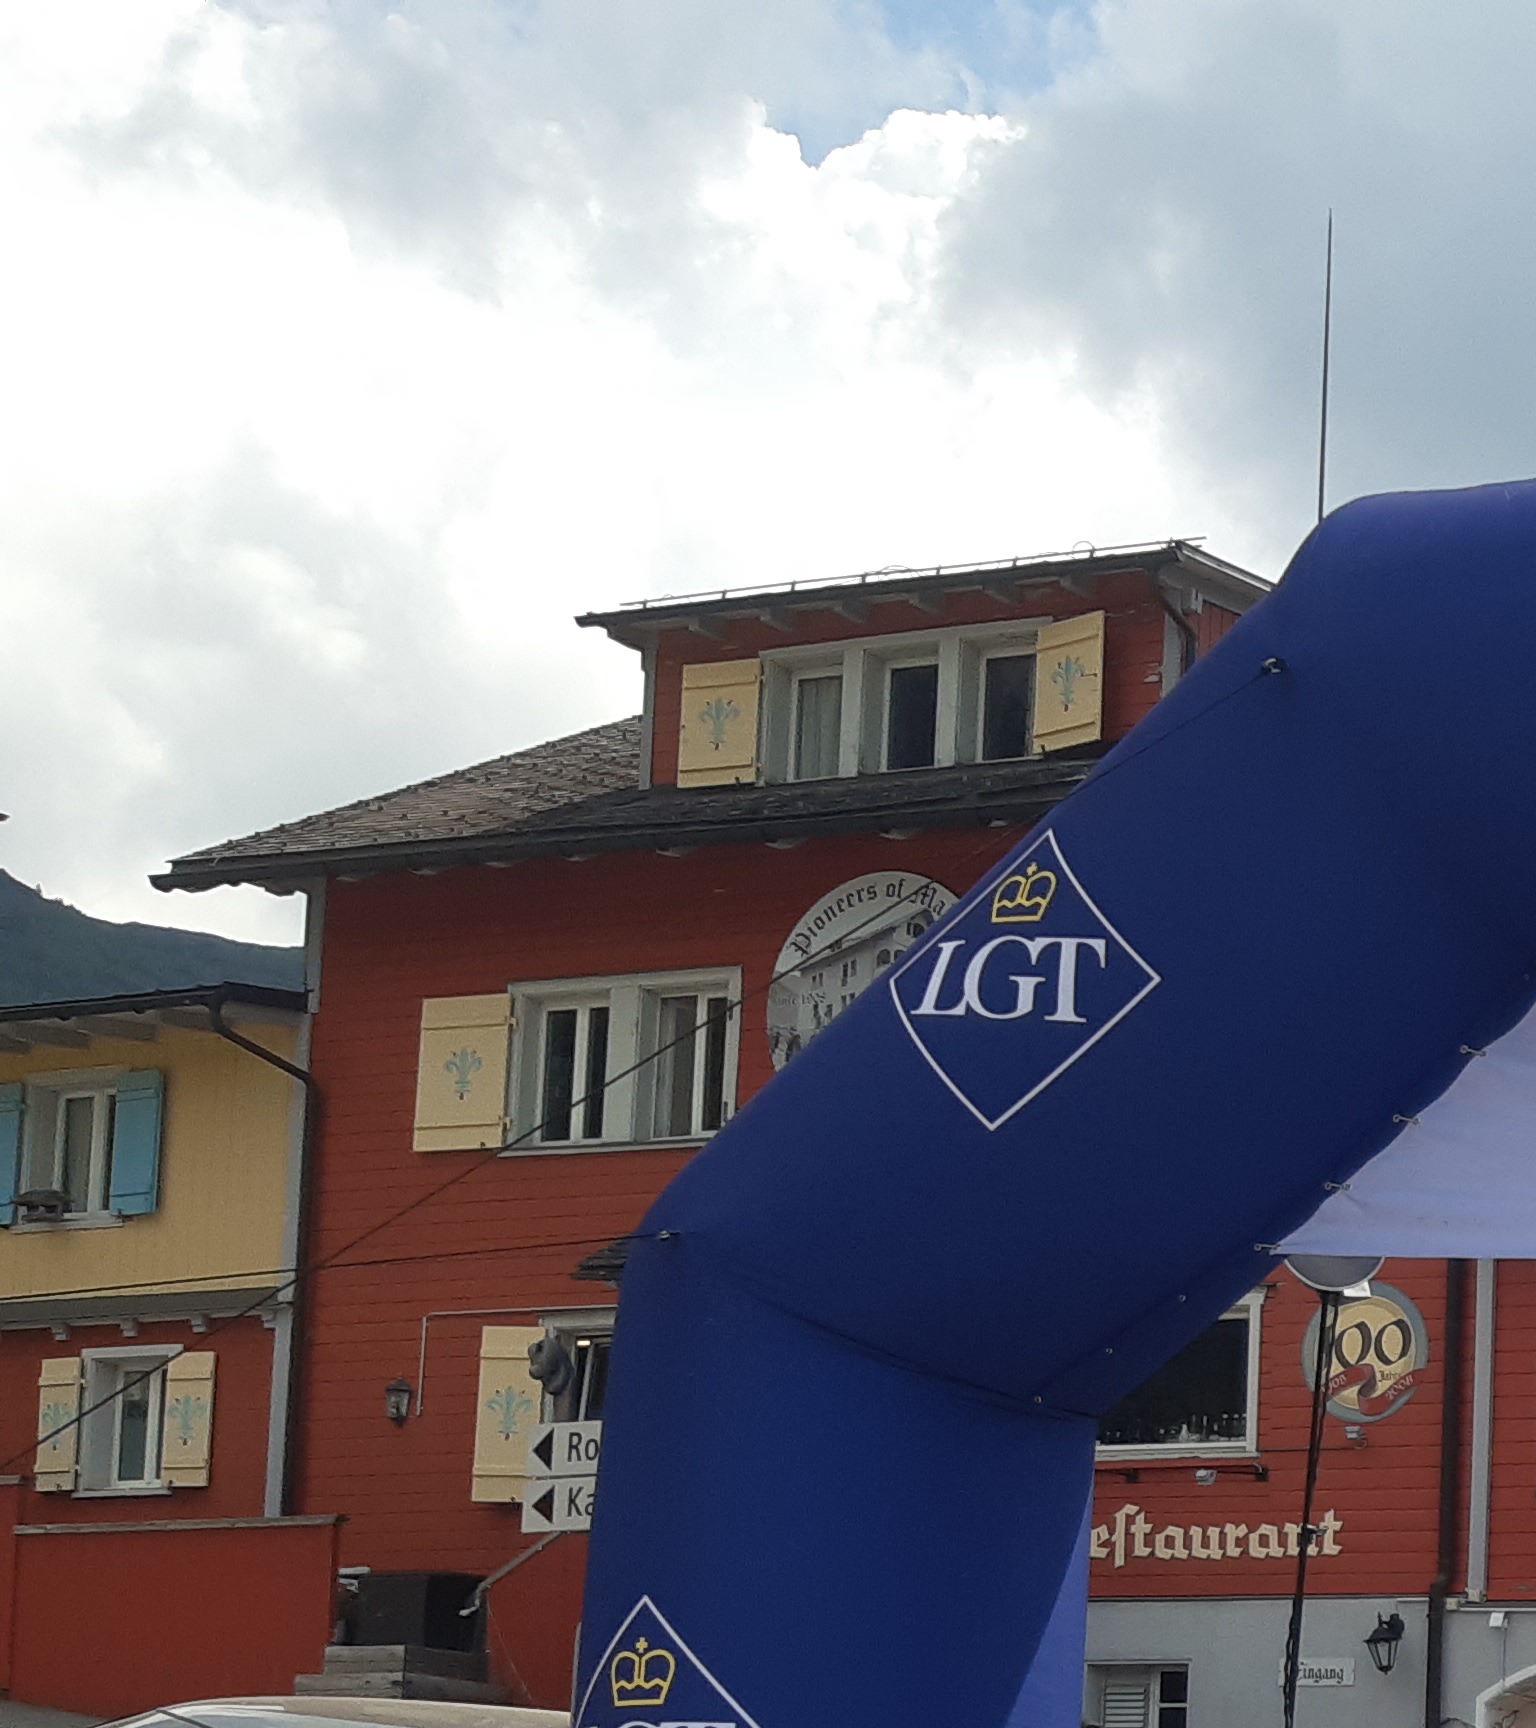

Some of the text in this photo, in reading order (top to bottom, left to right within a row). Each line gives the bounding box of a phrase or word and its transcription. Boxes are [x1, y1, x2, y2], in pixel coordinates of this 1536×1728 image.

[789, 878, 948, 958] Pioneers of Ma
[910, 934, 1106, 1024] LGT
[1328, 1318, 1412, 1369] 00
[566, 1431, 600, 1463] Ro
[566, 1485, 596, 1517] Ka
[1089, 1503, 1344, 1569] estaurant
[1297, 1660, 1345, 1684] ingang
